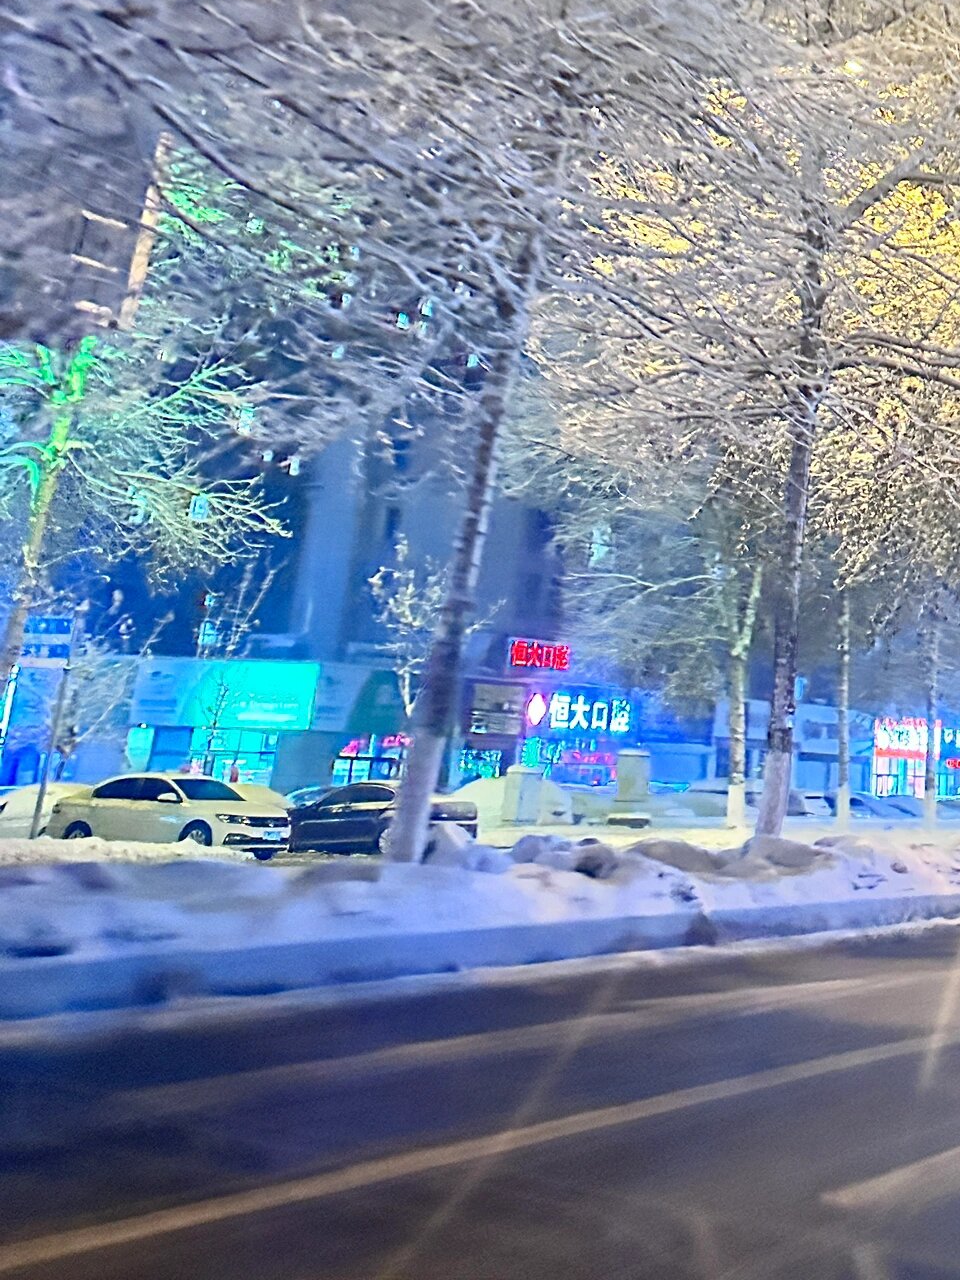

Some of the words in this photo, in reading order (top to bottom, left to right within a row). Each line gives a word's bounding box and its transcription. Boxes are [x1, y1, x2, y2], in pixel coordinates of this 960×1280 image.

[512, 640, 569, 670] 恒大口腔
[550, 694, 630, 732] 恒大口腔
